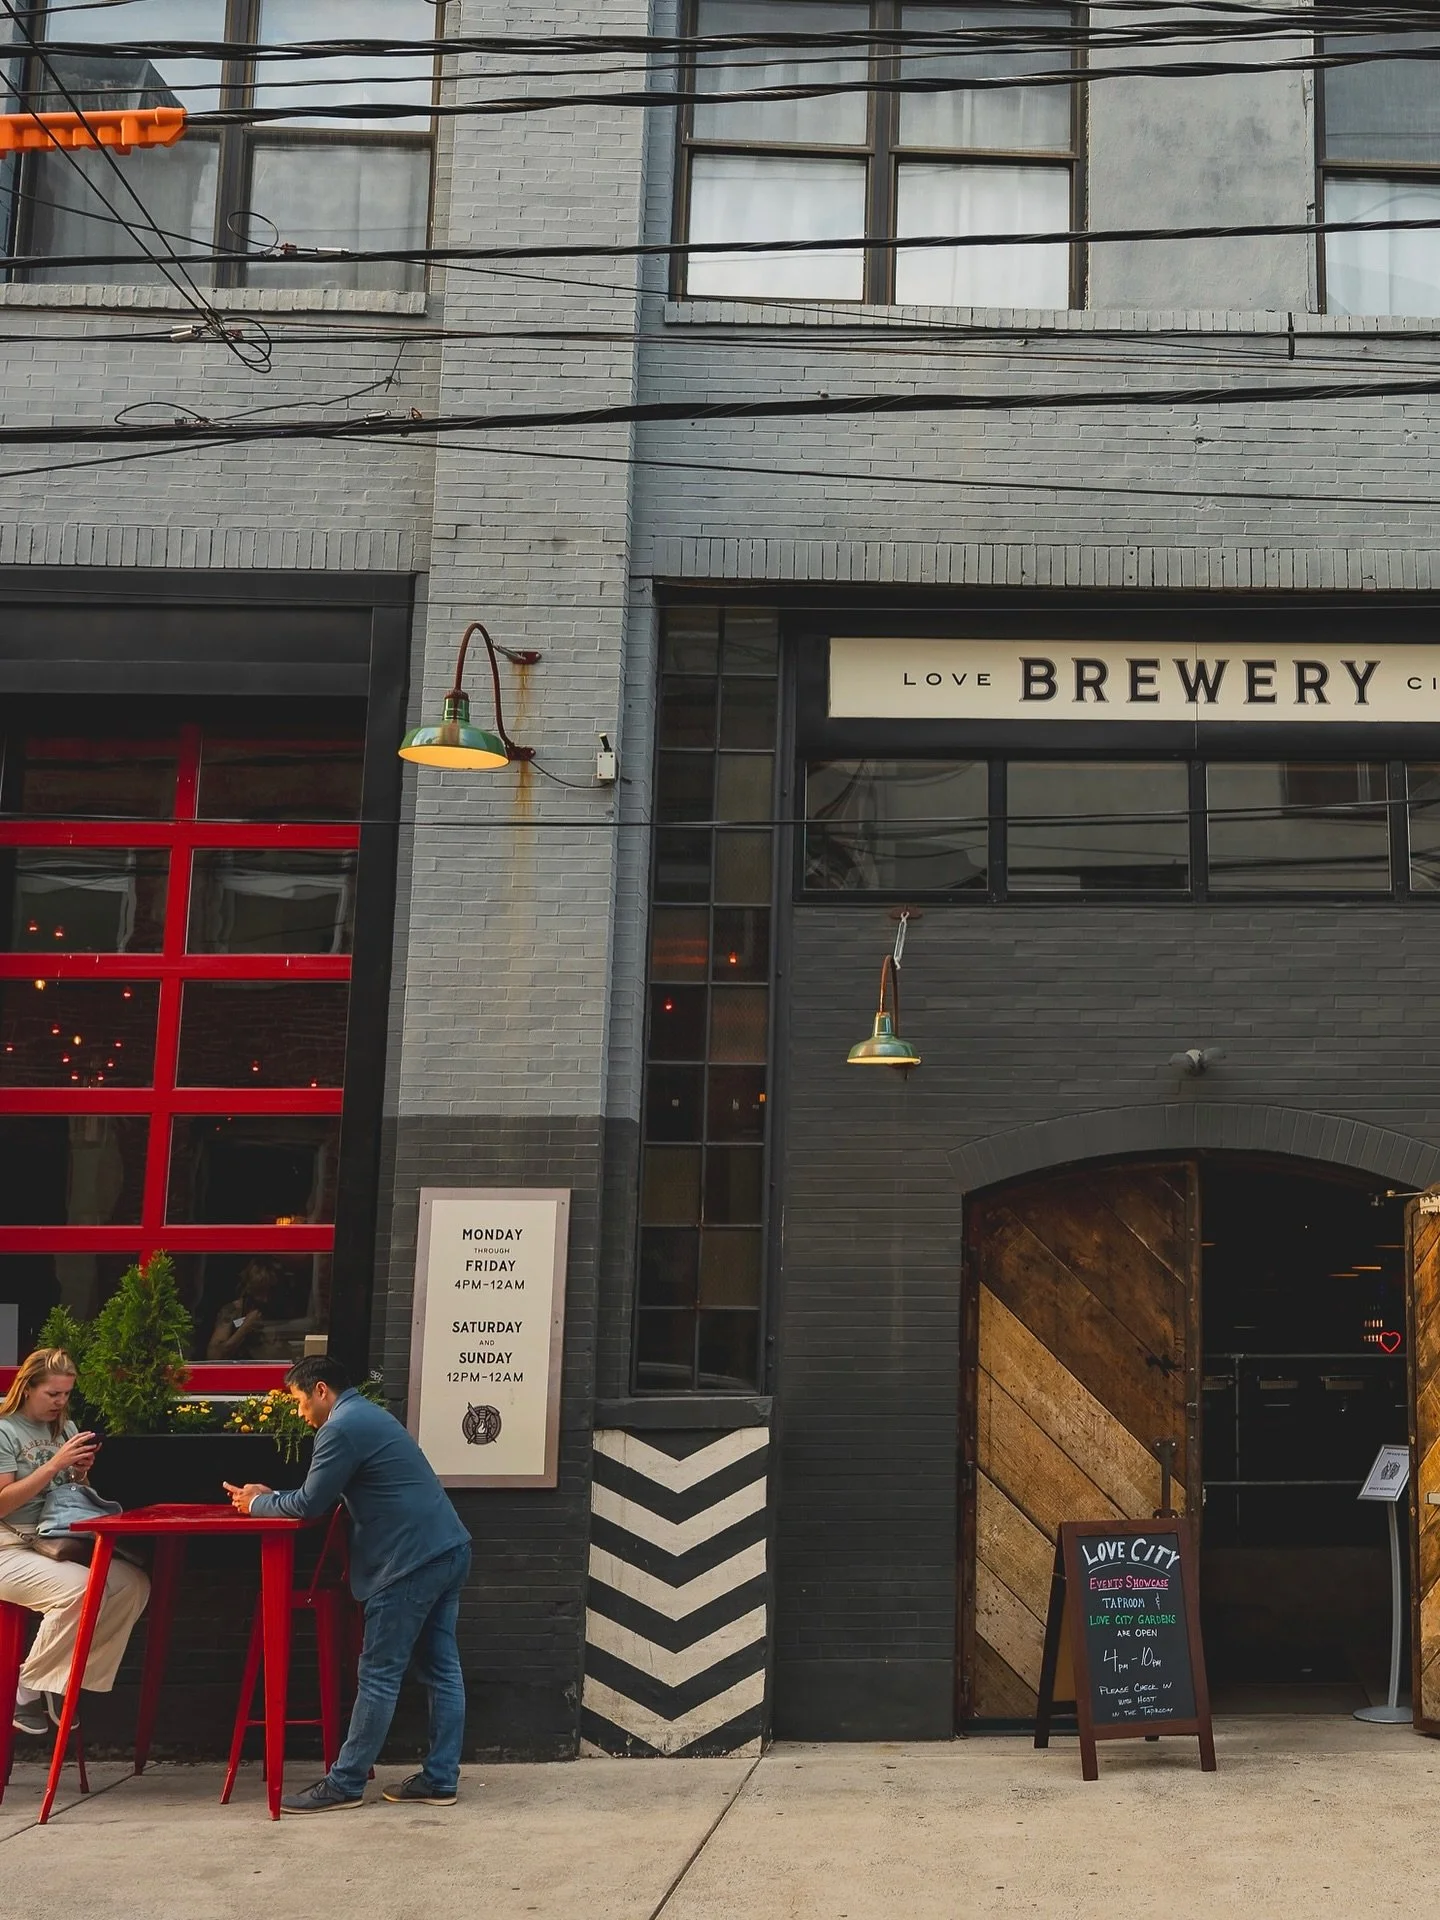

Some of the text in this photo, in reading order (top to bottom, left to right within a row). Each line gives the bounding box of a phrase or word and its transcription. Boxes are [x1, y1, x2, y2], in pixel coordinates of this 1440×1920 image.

[903, 672, 992, 686] LOVE
[1018, 656, 1381, 706] BREWERY
[462, 1228, 523, 1241] MONDAY
[465, 1259, 516, 1272] FRIDAY
[454, 1279, 525, 1290] 4PM-12AM
[452, 1321, 523, 1333] SATURDAY
[459, 1352, 513, 1364] SUNDAY
[446, 1372, 524, 1382] 12PM-12AM
[1082, 1537, 1180, 1569] LOVE CITY
[1101, 1597, 1145, 1609] TAPROOM
[1089, 1614, 1176, 1626] LOVE CITY GARDENS
[1135, 1628, 1158, 1637] OPEN
